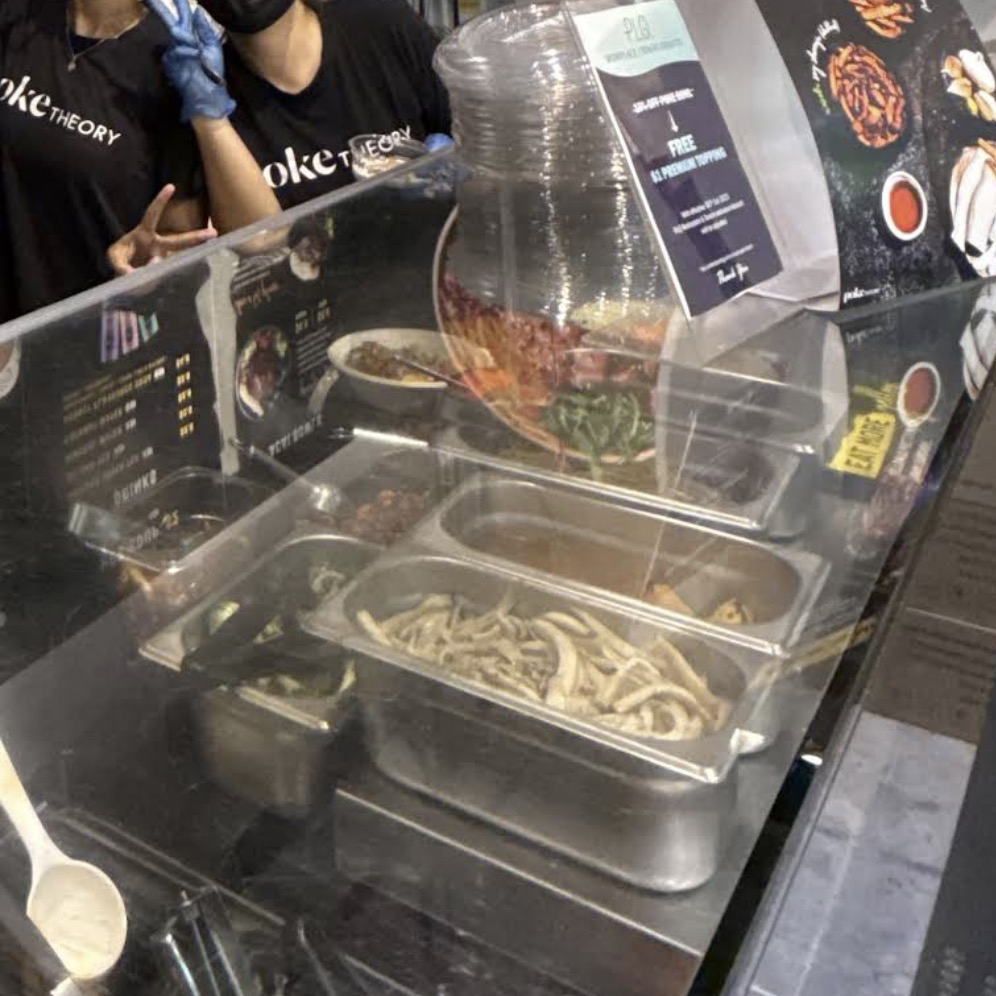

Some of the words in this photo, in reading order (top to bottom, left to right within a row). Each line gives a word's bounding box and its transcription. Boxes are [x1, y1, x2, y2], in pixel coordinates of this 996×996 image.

[49, 106, 122, 145] THEORY
[667, 134, 697, 157] FREE
[660, 156, 698, 180] PREMIUM
